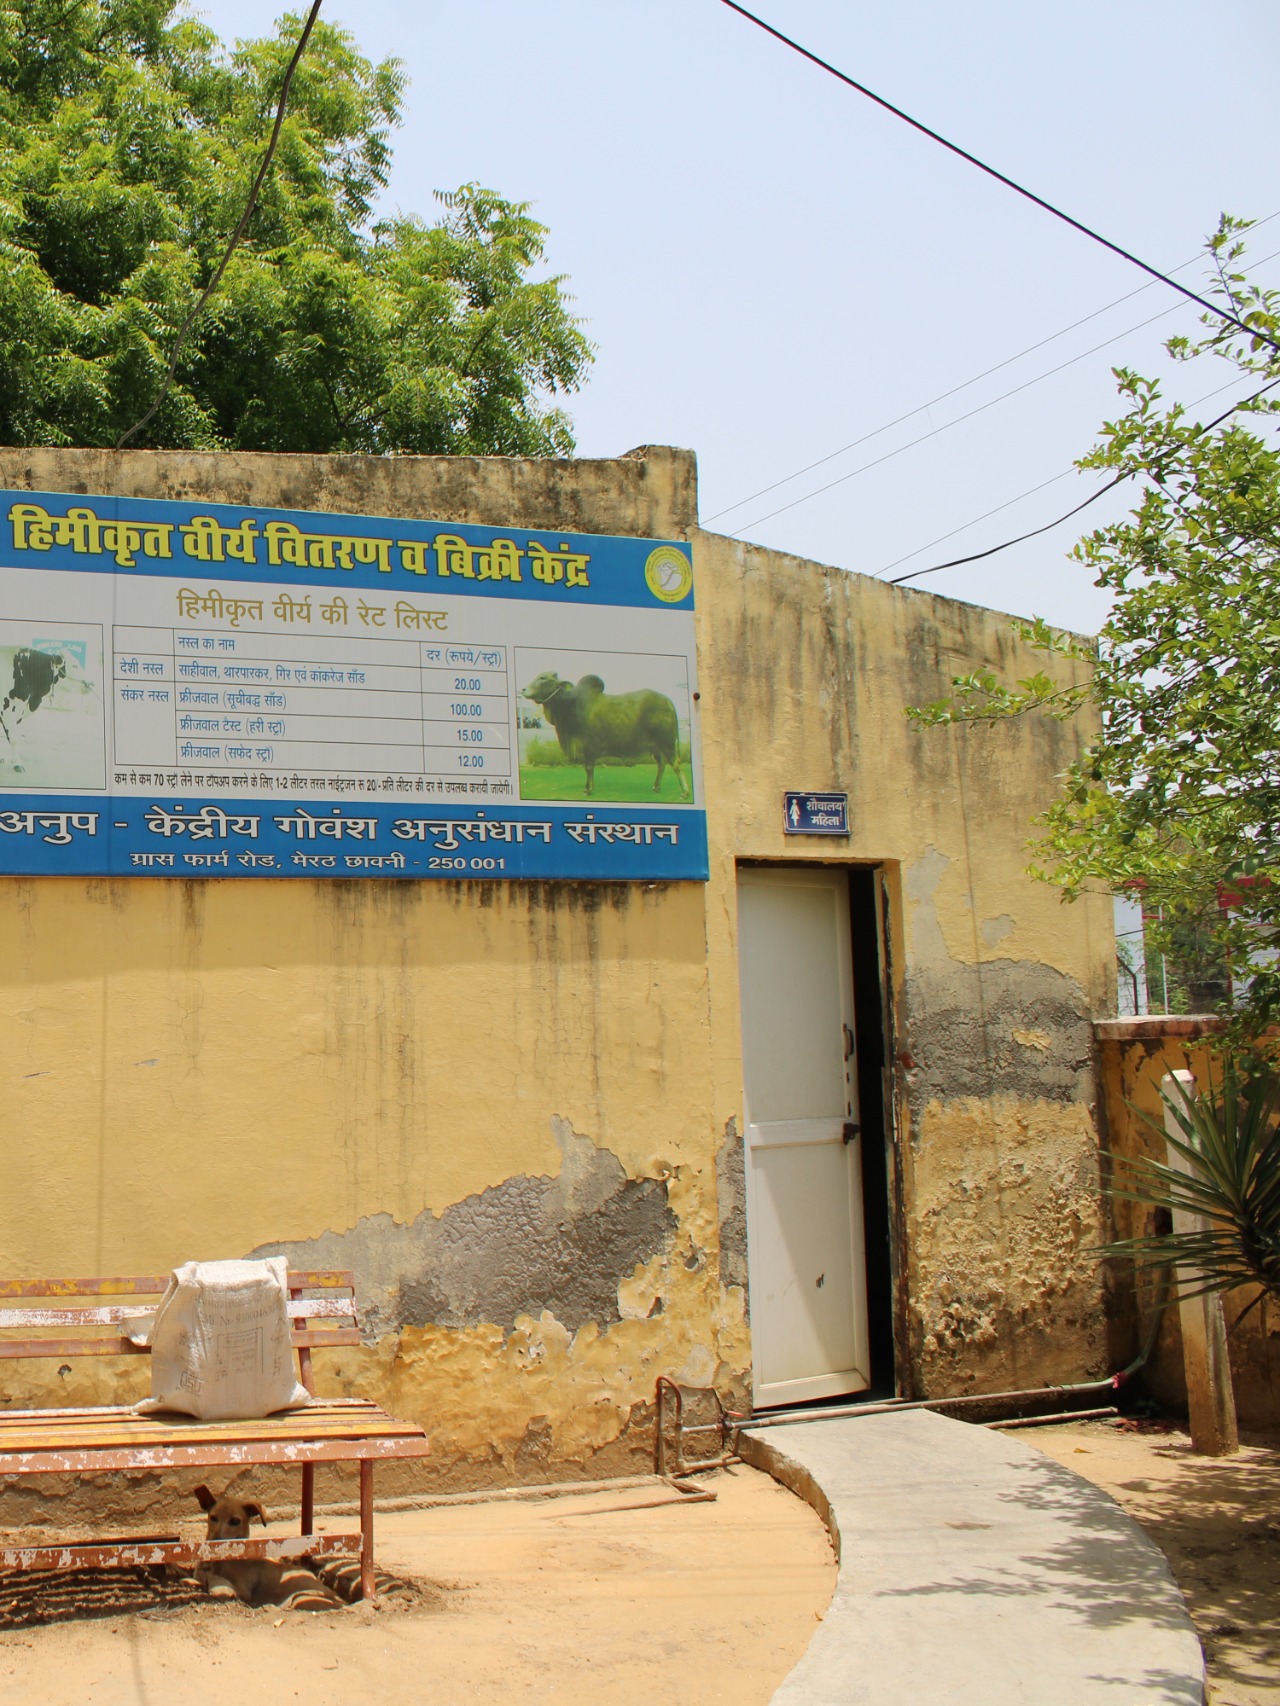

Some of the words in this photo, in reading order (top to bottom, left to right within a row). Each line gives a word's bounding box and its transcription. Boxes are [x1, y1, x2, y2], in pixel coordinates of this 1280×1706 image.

[7, 503, 175, 567] हिमीकृत
[179, 515, 260, 565] वीर्य
[264, 520, 393, 573] वितरण
[397, 540, 429, 576] व
[432, 533, 524, 582] बिक्री
[527, 540, 590, 588] केंद्र
[176, 587, 263, 627] हिमीकृत
[272, 593, 312, 624] वीर्य
[320, 596, 348, 626] की
[356, 598, 387, 627] रेट
[394, 601, 449, 631] लिस्ट
[178, 636, 199, 649] नस्ल
[202, 638, 215, 650] का
[218, 639, 235, 651] नाम
[426, 649, 441, 662] दर
[120, 658, 138, 674] देशी
[142, 663, 163, 675] नस्ल
[178, 660, 220, 679] साहीवाल,
[223, 666, 273, 682] थारपारकर,
[275, 664, 291, 681] गिर
[294, 665, 307, 683] एवं
[310, 666, 344, 683] कांकरेज
[454, 678, 481, 691] 20.00
[120, 685, 144, 702] संकर
[148, 689, 169, 702] नस्ल
[179, 687, 219, 704] फ्रीजवाल
[450, 703, 482, 717] 100.00
[180, 715, 220, 732] फ्रीजवाल
[245, 716, 264, 735] (हरी
[457, 729, 483, 742] 15.00
[180, 742, 220, 759] फ्रीजवाल
[457, 755, 484, 768] 12.00
[114, 773, 127, 786] कम
[129, 769, 137, 785] से
[138, 773, 152, 786] कम
[154, 774, 164, 786] 70
[180, 771, 193, 787] लेने
[195, 775, 204, 787] पर
[232, 772, 249, 788] करने
[250, 772, 258, 788] के
[259, 772, 273, 790] लिए
[276, 776, 288, 789] 1-2
[290, 773, 308, 789] लीटर
[310, 777, 326, 790] तरल
[382, 776, 394, 793] प्रति
[396, 776, 413, 793] लीटर
[415, 777, 424, 793] की
[426, 780, 435, 793] दर
[436, 778, 444, 793] से
[445, 781, 468, 794] उपलब्ध
[144, 804, 261, 840] केंद्रीय
[273, 807, 378, 842] गोवंश
[391, 811, 553, 850] अनुसंधान
[563, 813, 680, 846] संस्थान
[810, 812, 840, 826] महिला
[129, 852, 175, 867] ग्रास
[182, 850, 229, 868] फार्म
[236, 850, 283, 870] रोड,
[291, 850, 337, 869] मेरठ
[344, 851, 406, 870] छावनी
